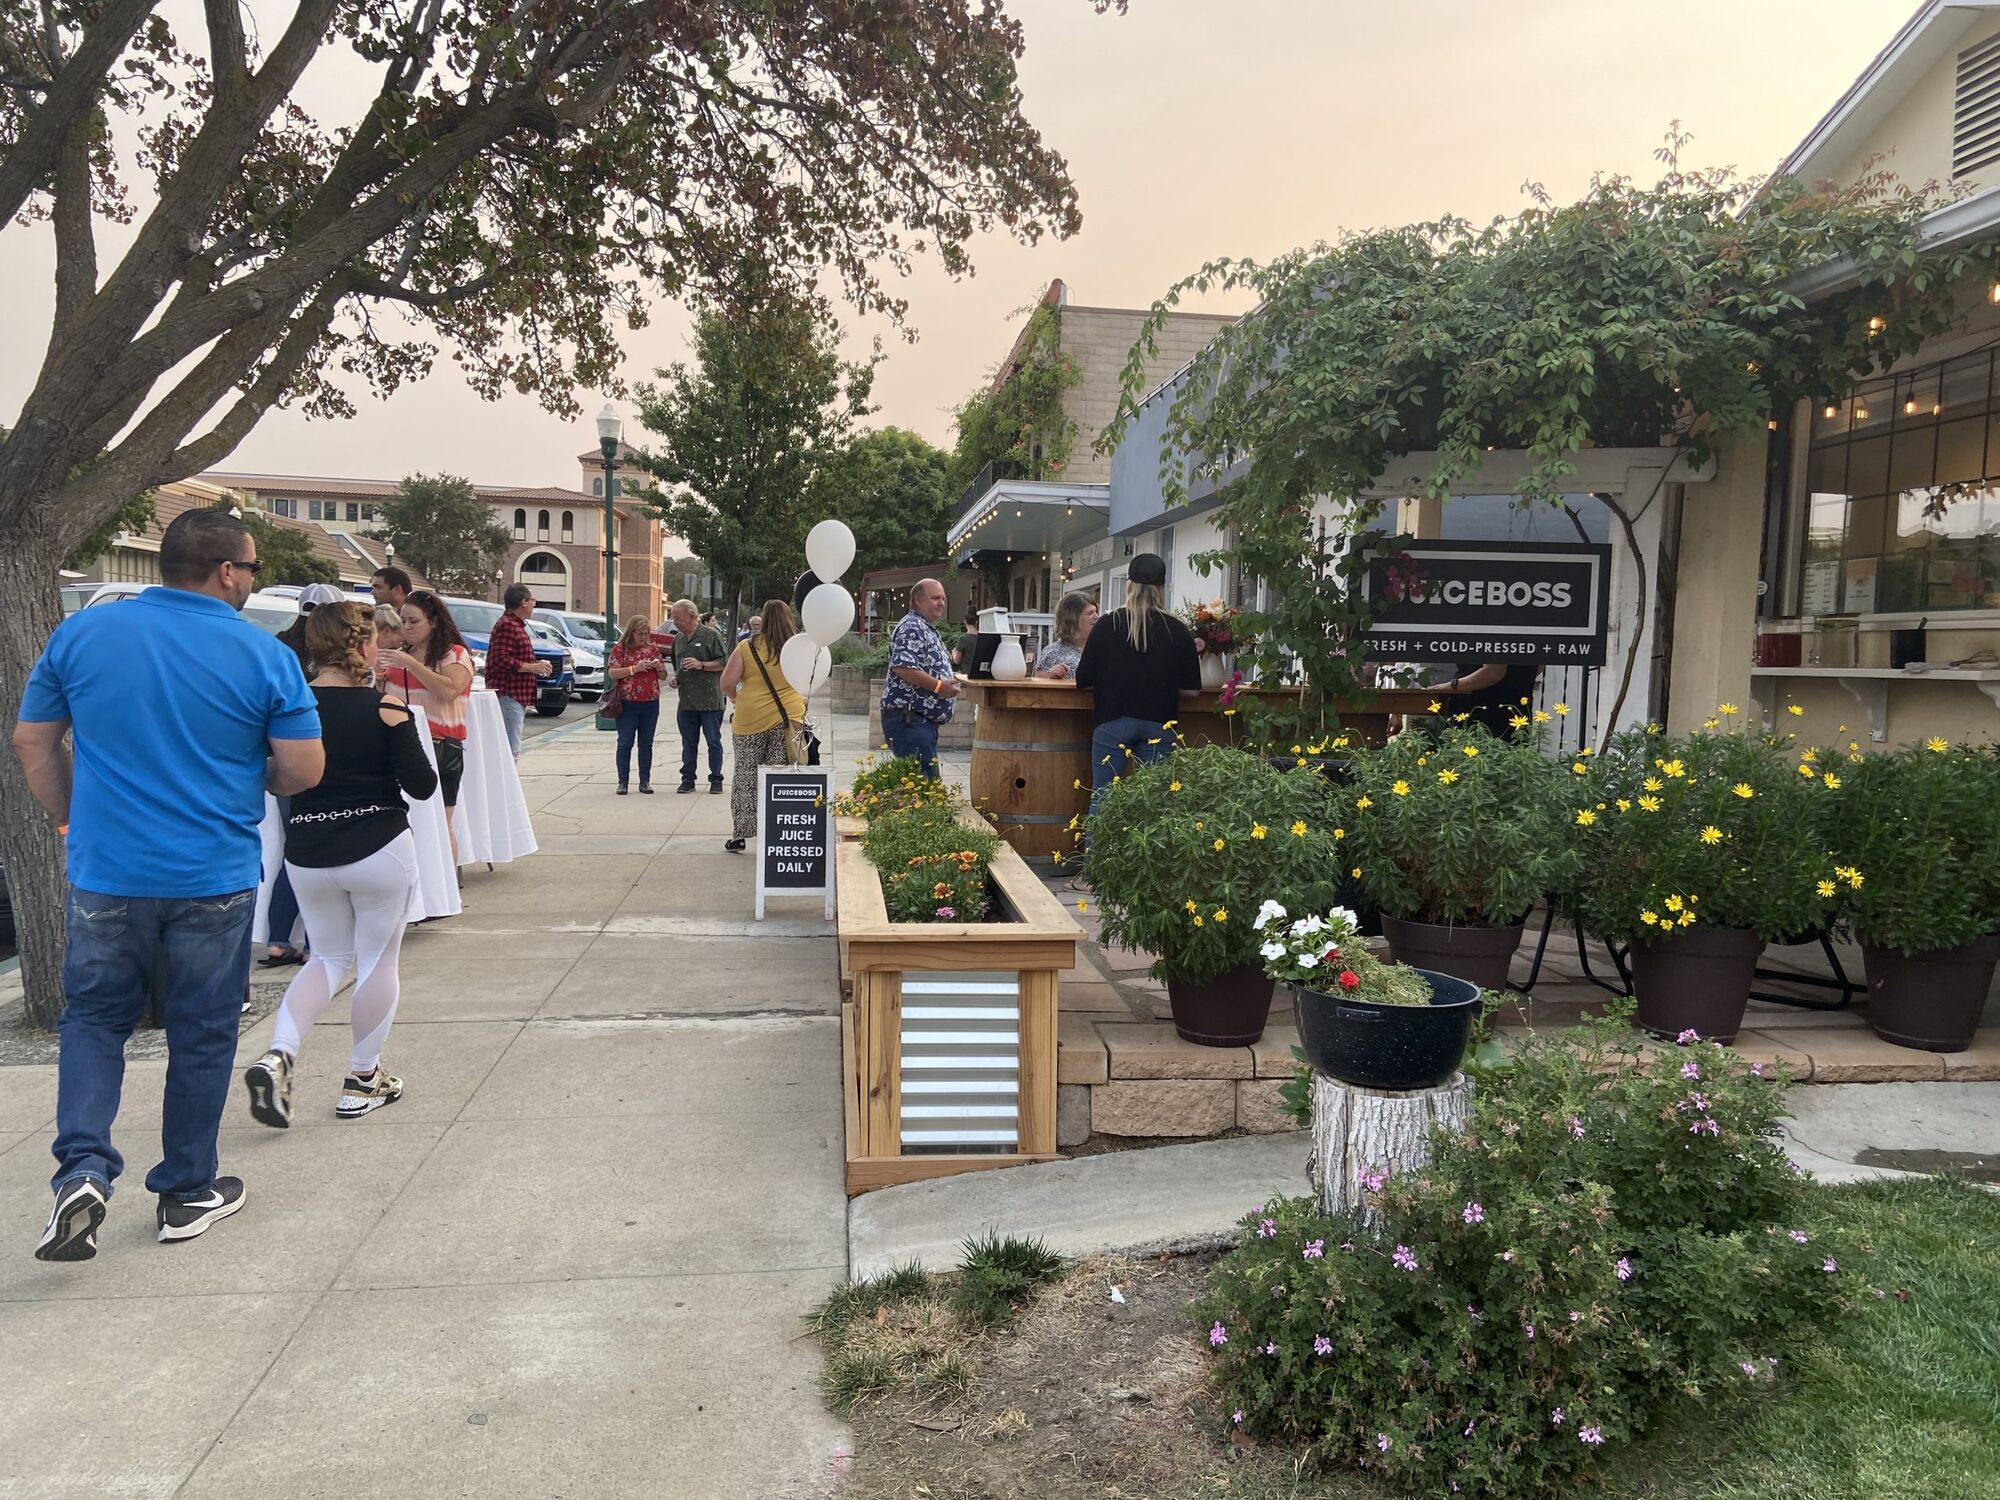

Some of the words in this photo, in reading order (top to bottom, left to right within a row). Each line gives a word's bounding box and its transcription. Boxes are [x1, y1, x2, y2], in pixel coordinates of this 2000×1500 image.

[1429, 641, 1536, 654] COLD-PRESSED
[1558, 643, 1591, 655] RAW
[776, 814, 816, 825] FRESH
[779, 830, 813, 841] JUICE
[767, 846, 824, 857] PRESSED
[777, 862, 813, 873] DAILY
